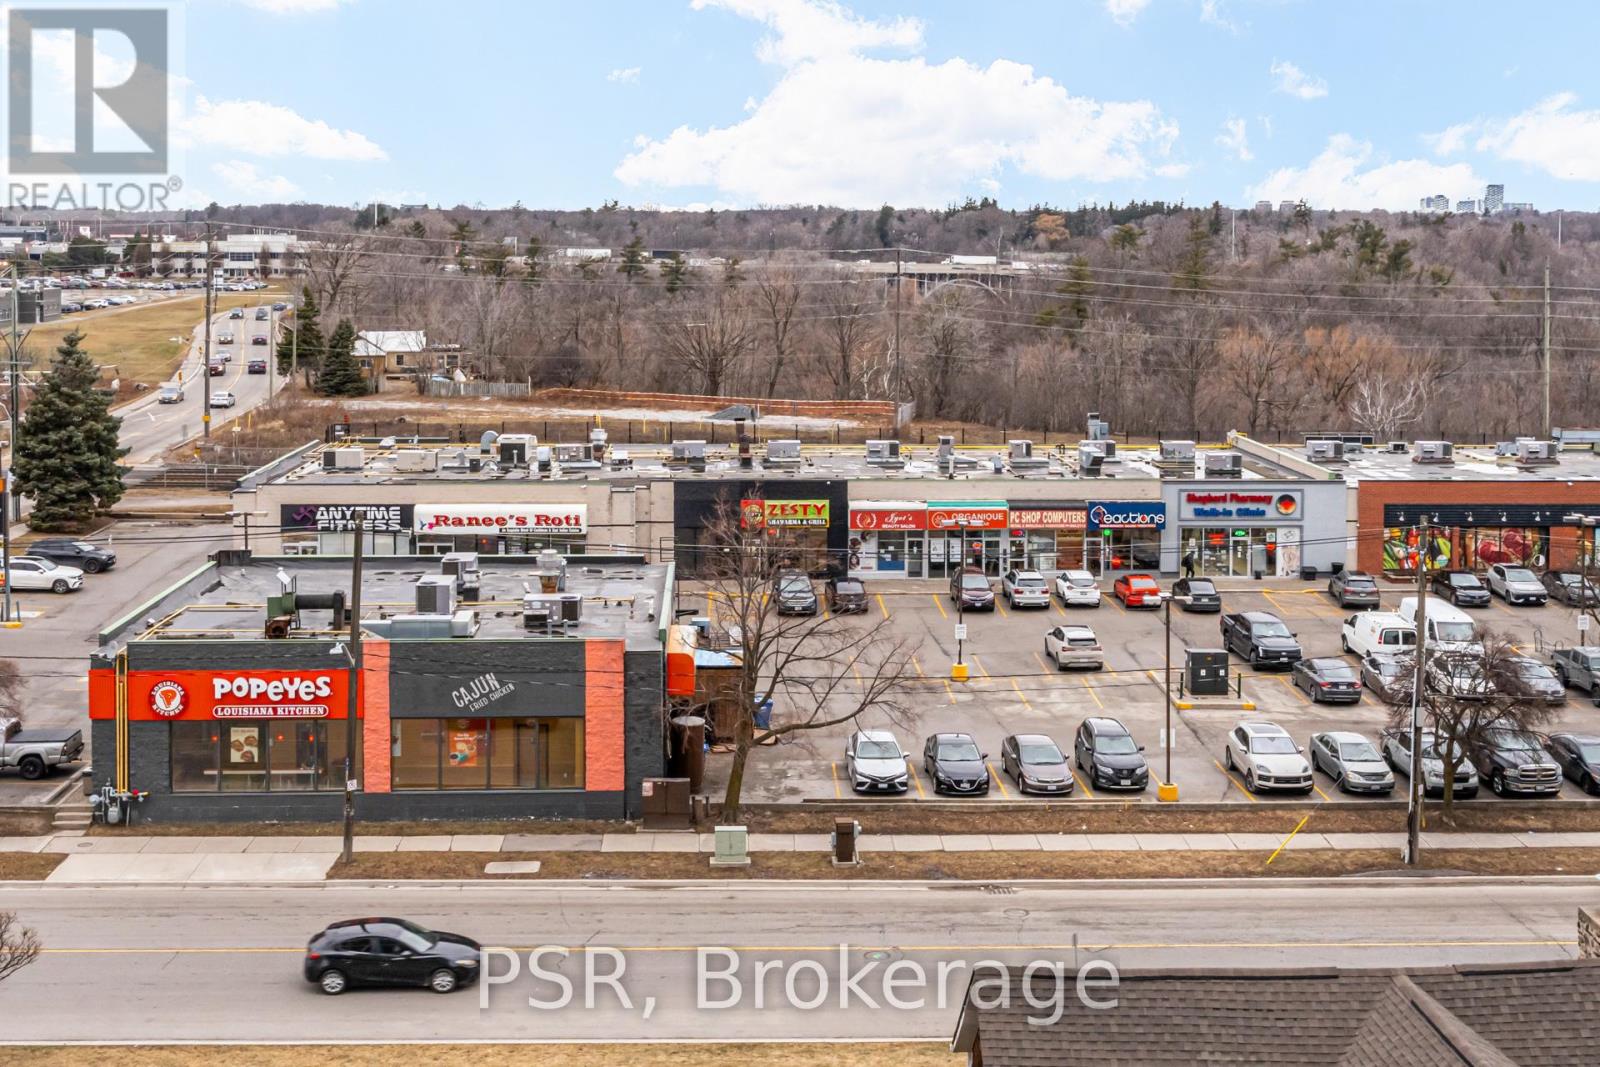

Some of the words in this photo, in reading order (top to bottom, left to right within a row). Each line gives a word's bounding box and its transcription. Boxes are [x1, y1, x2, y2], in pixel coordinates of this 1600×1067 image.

[315, 506, 401, 520] ANYTIME
[767, 503, 826, 516] ZESTY
[433, 514, 528, 527] Ranee's
[534, 514, 582, 527] Roti
[1010, 511, 1020, 523] PC
[1021, 511, 1041, 523] SHOP
[1042, 511, 1086, 523] COMPUTERS
[451, 672, 501, 708] CAJUN
[468, 697, 489, 712] FRIED
[489, 683, 515, 701] CHICKEN
[217, 707, 274, 716] LOUISIANA
[277, 706, 324, 715] KITCHEN
